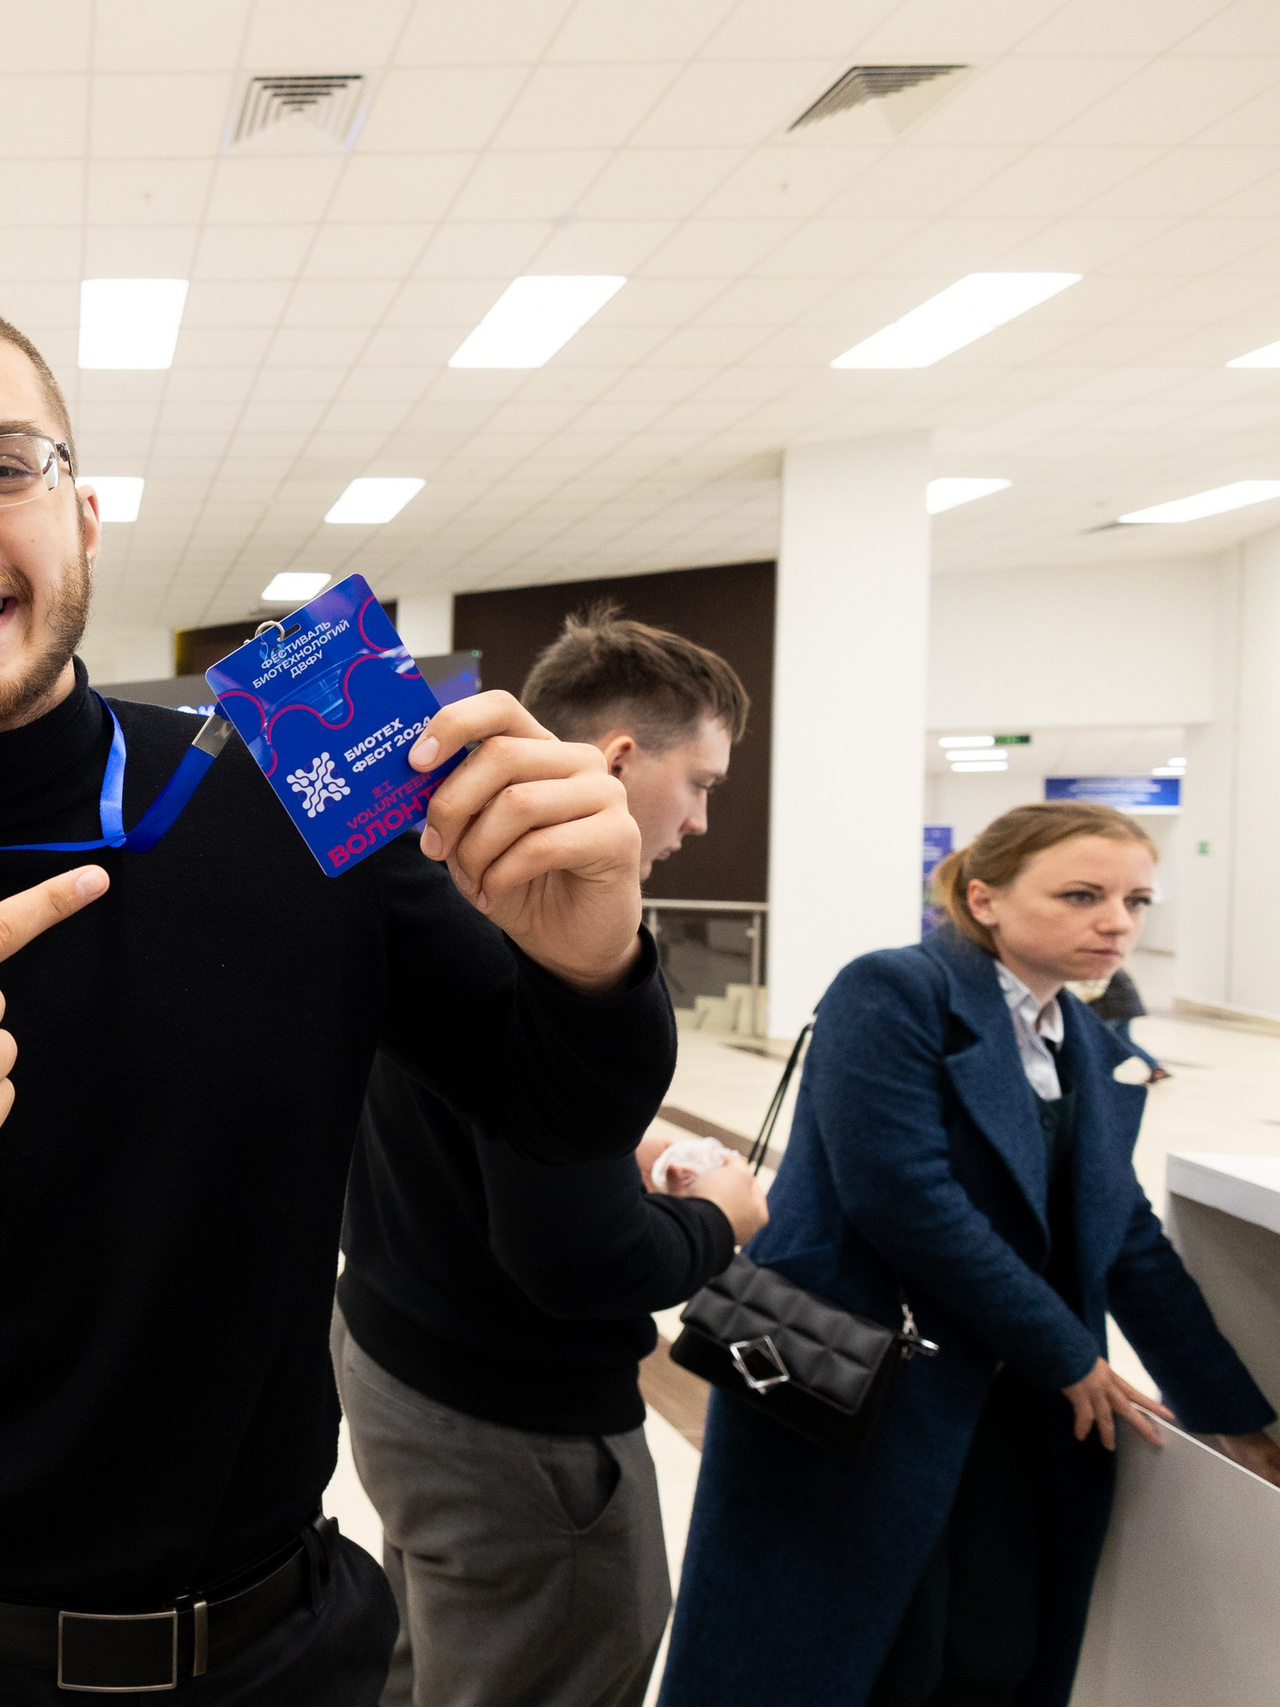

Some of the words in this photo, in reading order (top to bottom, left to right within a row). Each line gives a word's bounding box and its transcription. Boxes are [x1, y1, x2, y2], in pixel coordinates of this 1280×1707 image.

[252, 619, 350, 688] БИОТЕХНОЛОГИЙ
[261, 621, 331, 669] ФЕСТИВАЛЬ
[290, 650, 323, 678] ДВФУ
[343, 718, 404, 762] БИОТЕХ
[352, 741, 393, 773] ФЕСТ
[395, 715, 432, 747] 2024
[346, 772, 433, 829] VOLUNTEER
